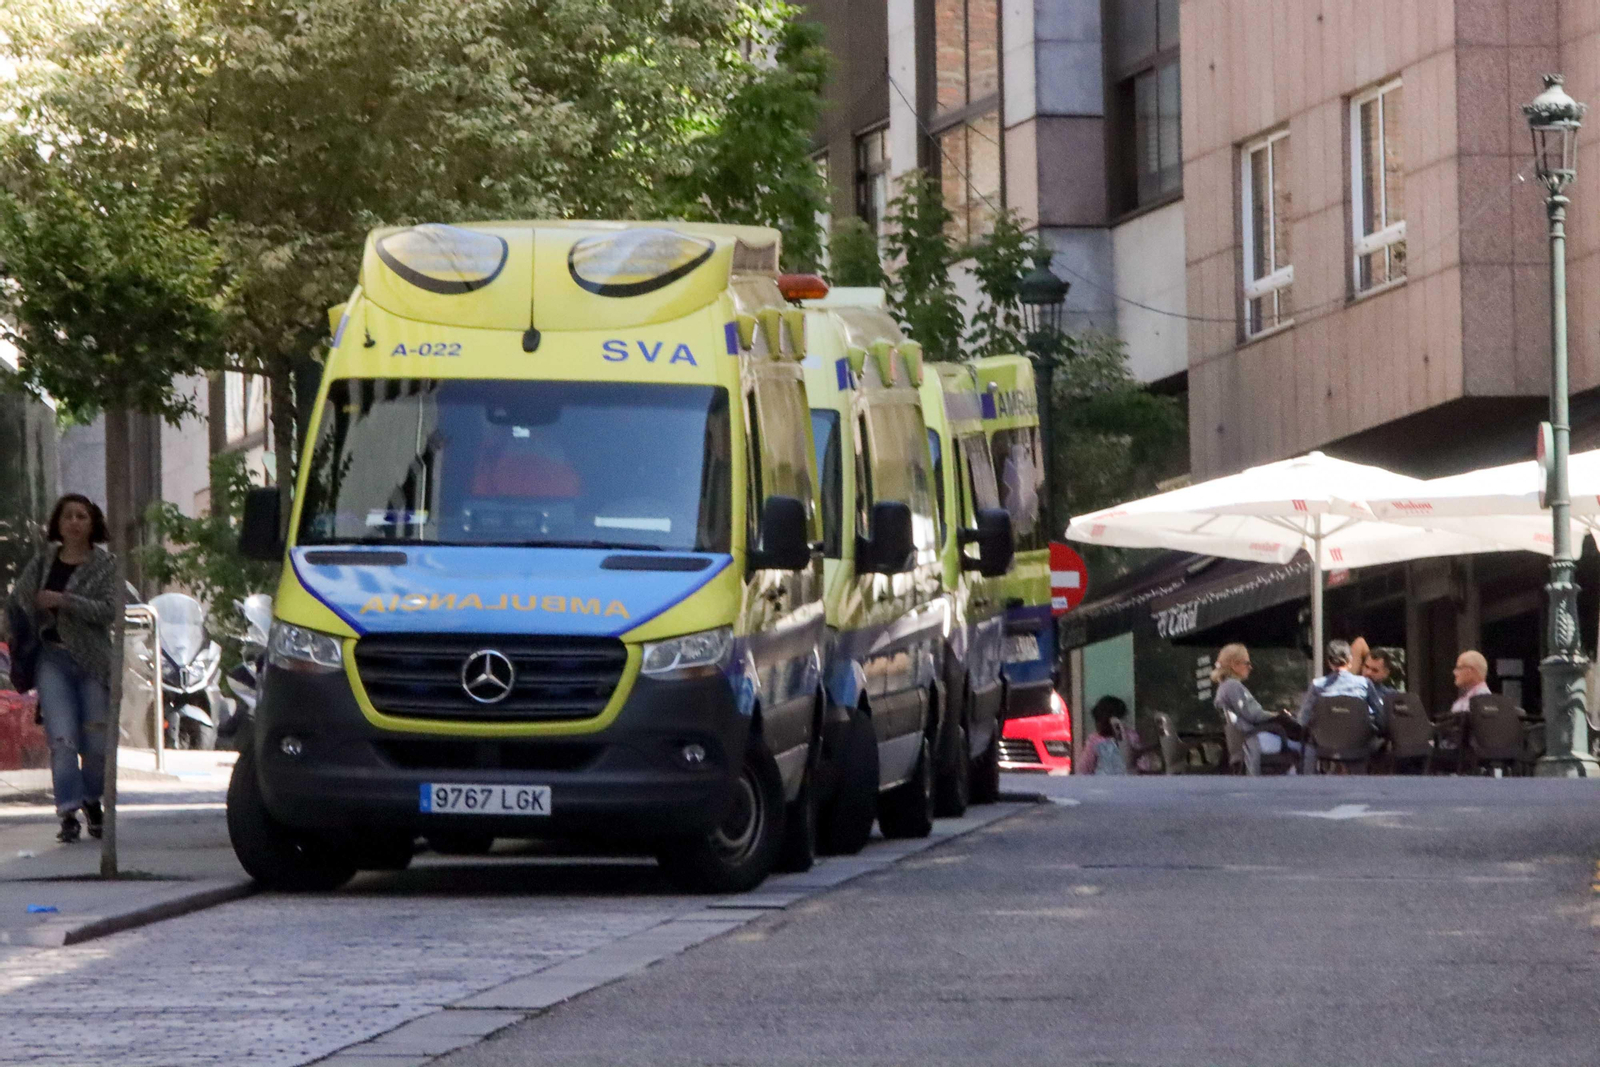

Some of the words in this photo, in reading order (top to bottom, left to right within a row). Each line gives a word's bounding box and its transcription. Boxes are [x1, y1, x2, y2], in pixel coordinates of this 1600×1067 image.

[391, 342, 462, 358] A-022
[602, 340, 698, 366] SVA
[436, 787, 493, 810] 9767
[501, 788, 544, 812] LGK
